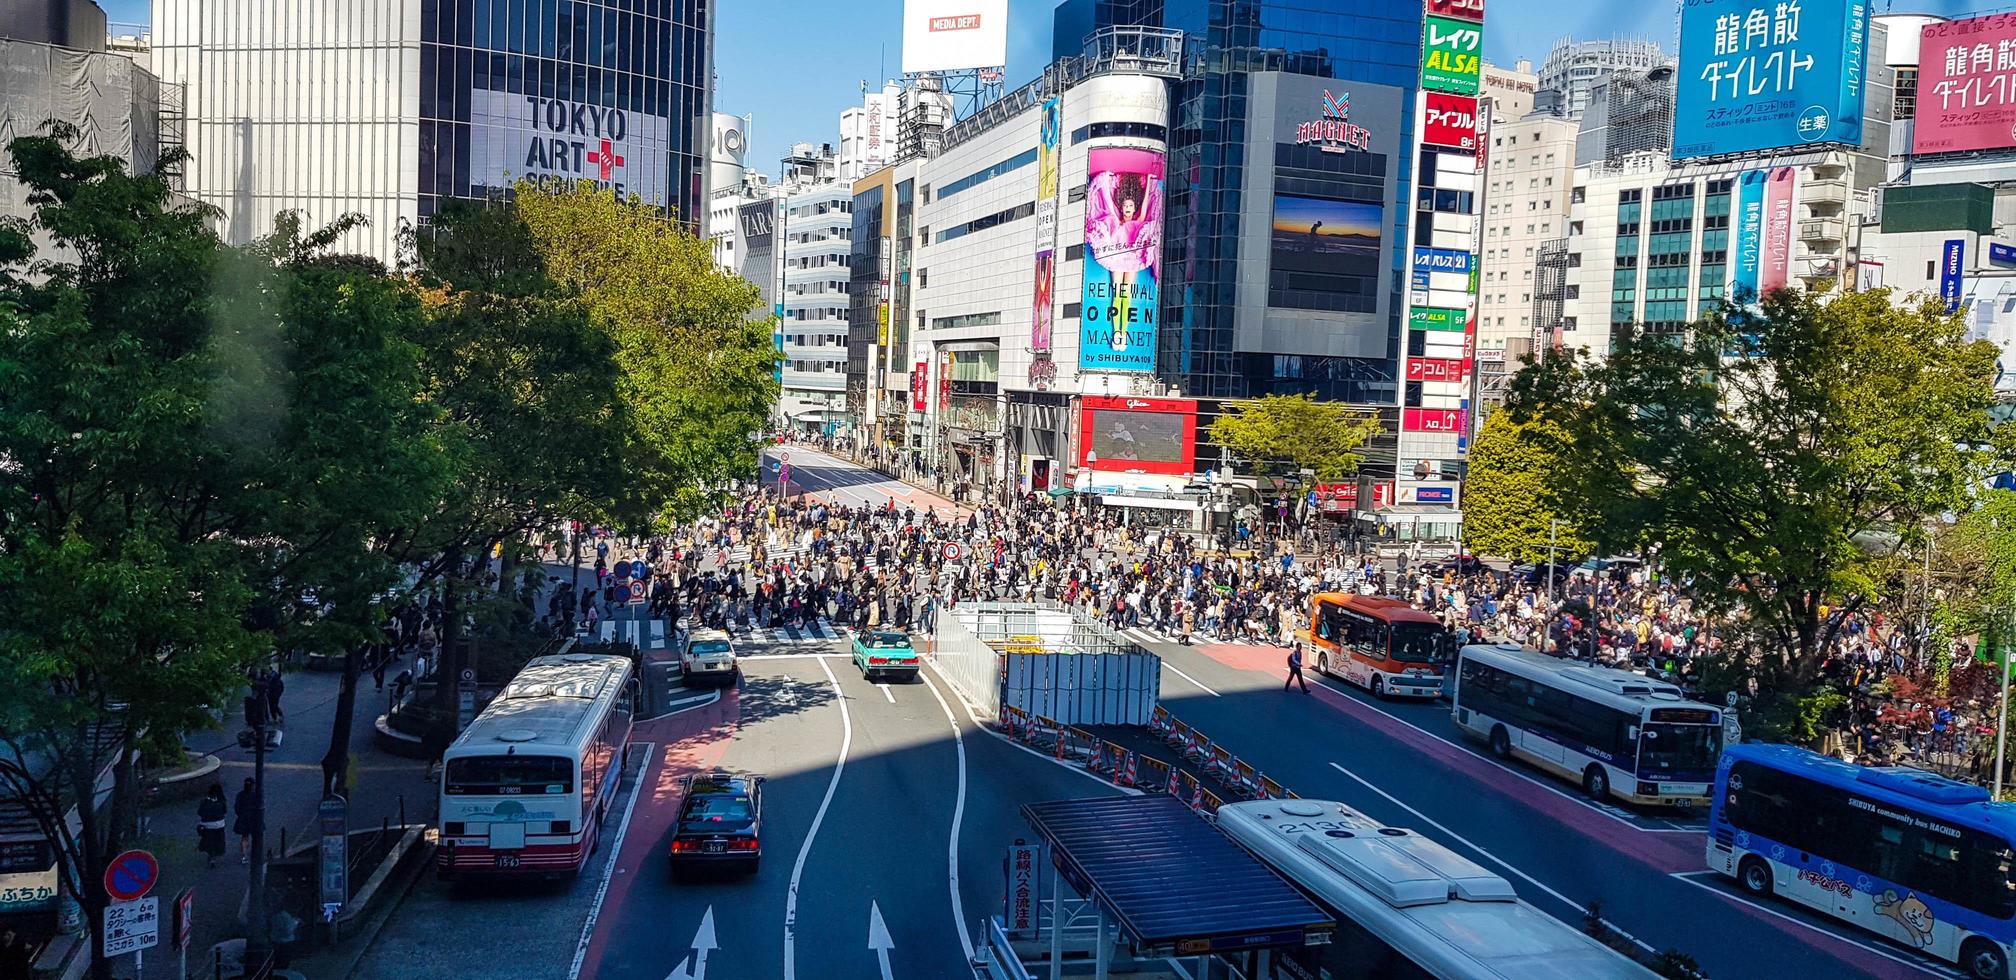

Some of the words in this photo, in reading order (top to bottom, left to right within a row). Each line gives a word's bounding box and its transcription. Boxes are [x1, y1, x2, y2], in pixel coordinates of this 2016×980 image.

[933, 18, 957, 30] MEDIA
[957, 16, 979, 28] DEPT.
[1714, 1, 1802, 56] 龍角散
[1429, 24, 1480, 51] レイク
[1426, 50, 1478, 76] ALSA
[1485, 74, 1505, 89] TOKYU
[1505, 78, 1515, 91] REI
[1516, 81, 1534, 94] HOTEL
[1701, 50, 1814, 101] ダイレクト
[527, 96, 625, 141] TOKYO
[1427, 108, 1475, 130] アイフル
[1706, 104, 1754, 121] スティック
[1757, 103, 1777, 111] ミント
[1940, 112, 1981, 122] スティック
[1799, 115, 1827, 132] 生薬
[1296, 119, 1371, 152] MAGNET
[1460, 136, 1474, 147] 8F
[526, 136, 585, 173] ART
[742, 212, 774, 238] ZARA
[1414, 252, 1467, 269] レオパレス21
[1950, 244, 1960, 275] MIZUHO
[1088, 282, 1154, 300] RENEWAL
[1087, 305, 1153, 324] OPEN
[1410, 310, 1427, 320] レイク
[1427, 312, 1446, 321] ALSA
[1455, 315, 1465, 324] 5F
[1086, 330, 1153, 348] MAGNET
[1464, 334, 1472, 358] アコム
[1085, 354, 1096, 364] by
[1097, 354, 1152, 364] SHIBUYA109
[1411, 362, 1446, 376] アコム
[1126, 399, 1150, 409] Glico
[1425, 420, 1439, 429] 入口
[1728, 693, 1736, 703] 27
[1599, 750, 1613, 761] BUS
[1848, 798, 1876, 814] SHIBUYA
[1876, 806, 1914, 826] community
[1914, 817, 1929, 828] bus
[1929, 821, 1962, 839] HACHIKO
[1015, 849, 1031, 929] 路線バス合流注意
[1798, 868, 1852, 898] ハチ公バス
[1, 885, 53, 902] ぶちか
[107, 938, 134, 952] ここから
[140, 934, 156, 945] 10m
